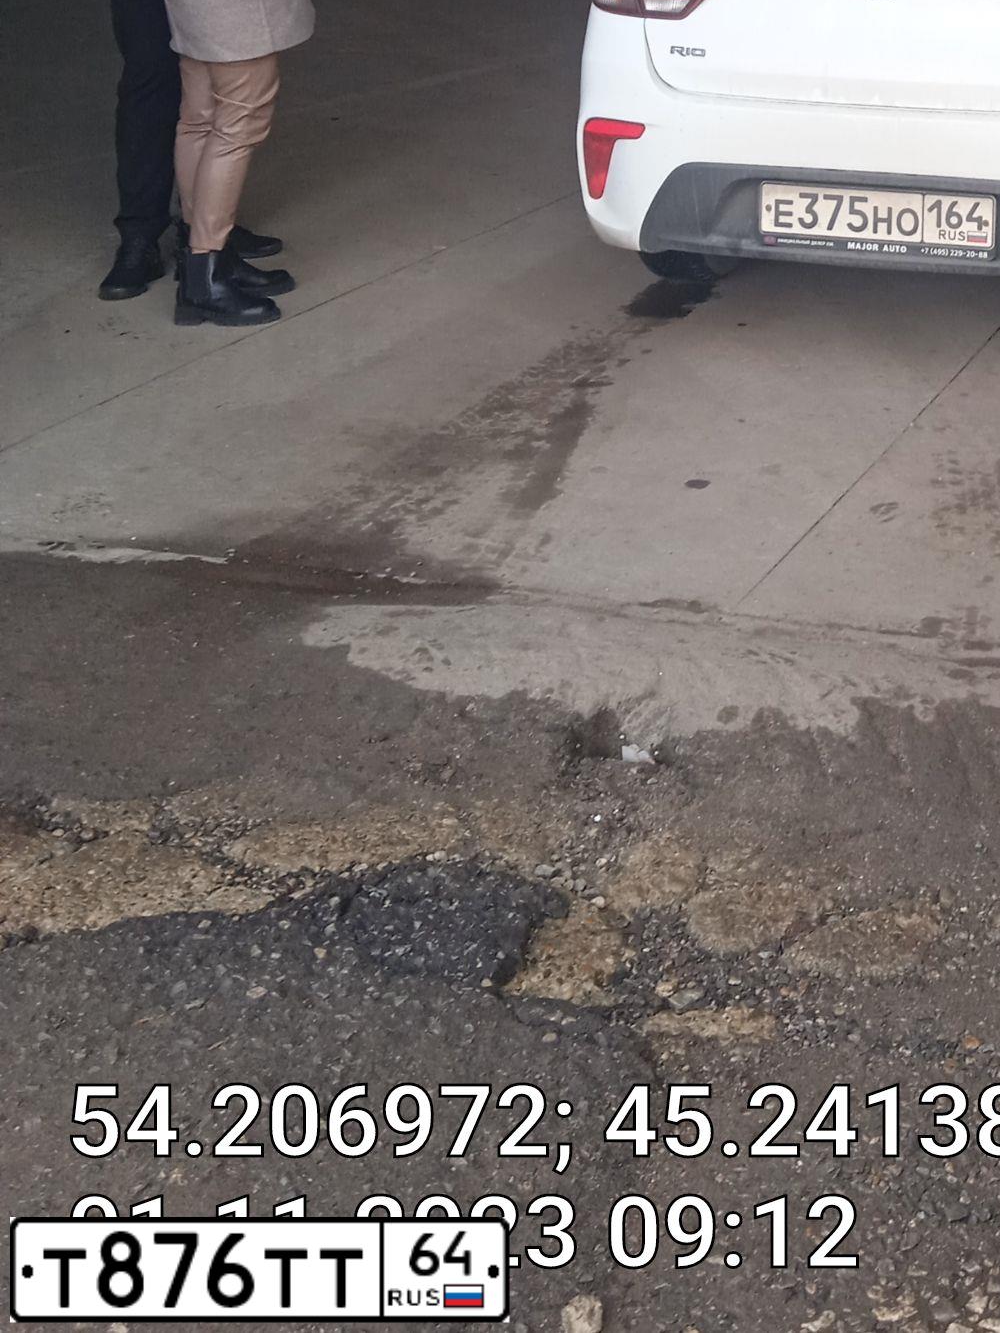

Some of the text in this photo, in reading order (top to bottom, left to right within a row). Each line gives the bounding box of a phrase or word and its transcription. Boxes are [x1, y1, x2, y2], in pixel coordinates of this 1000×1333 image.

[670, 45, 706, 57] RIO
[773, 192, 984, 237] Е375НО 164
[938, 229, 966, 242] RUS
[847, 241, 908, 254] MAJOR AUTO
